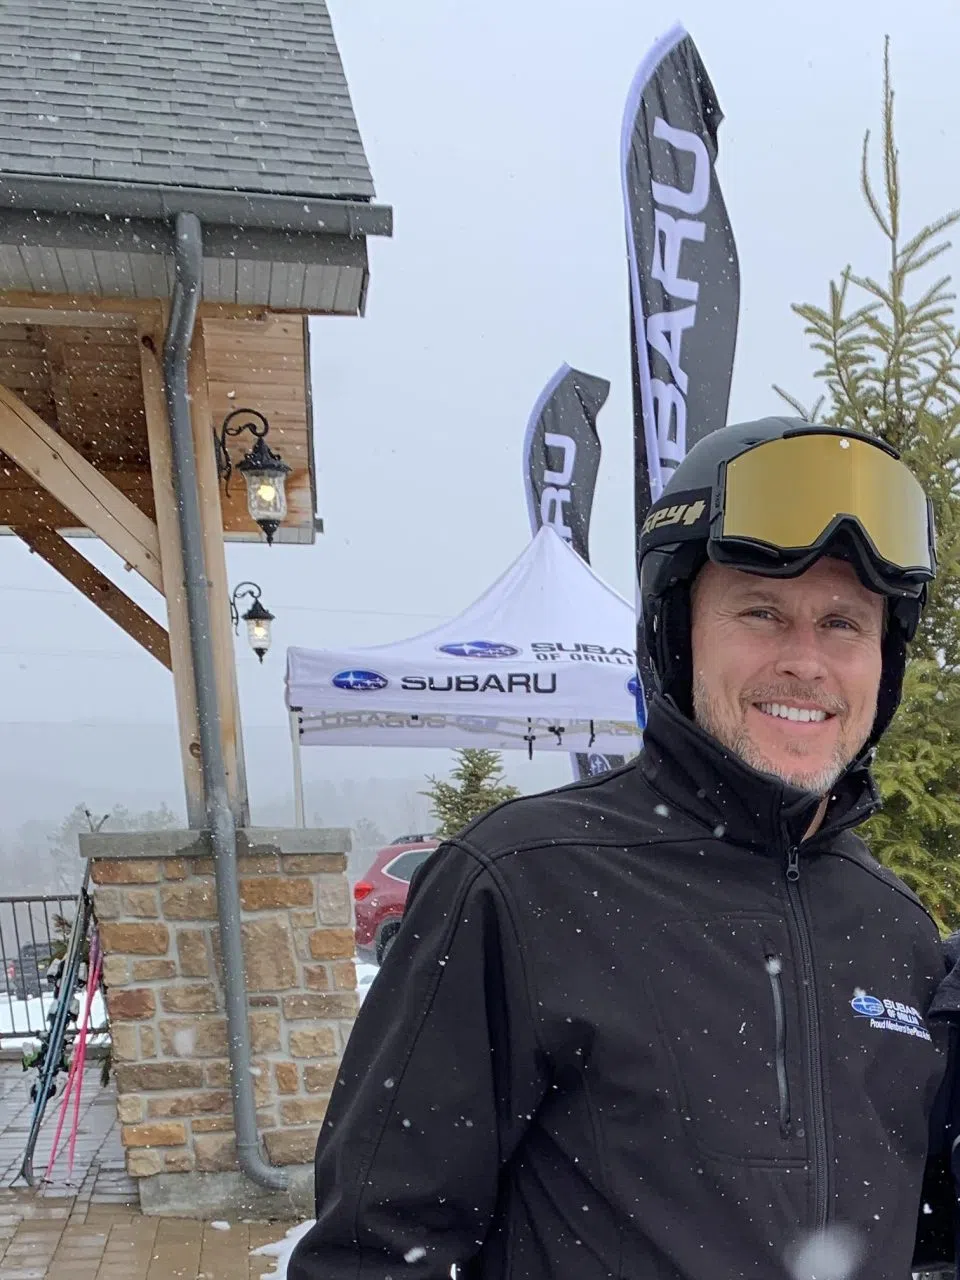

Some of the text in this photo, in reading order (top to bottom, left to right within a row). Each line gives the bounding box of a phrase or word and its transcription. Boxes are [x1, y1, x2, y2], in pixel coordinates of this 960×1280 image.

[646, 116, 711, 487] BARU
[540, 432, 577, 540] RU
[530, 642, 637, 657] SUBA
[536, 653, 634, 665] OF ORILLI
[401, 672, 557, 694] SUBARU
[882, 999, 923, 1021] SUBAR
